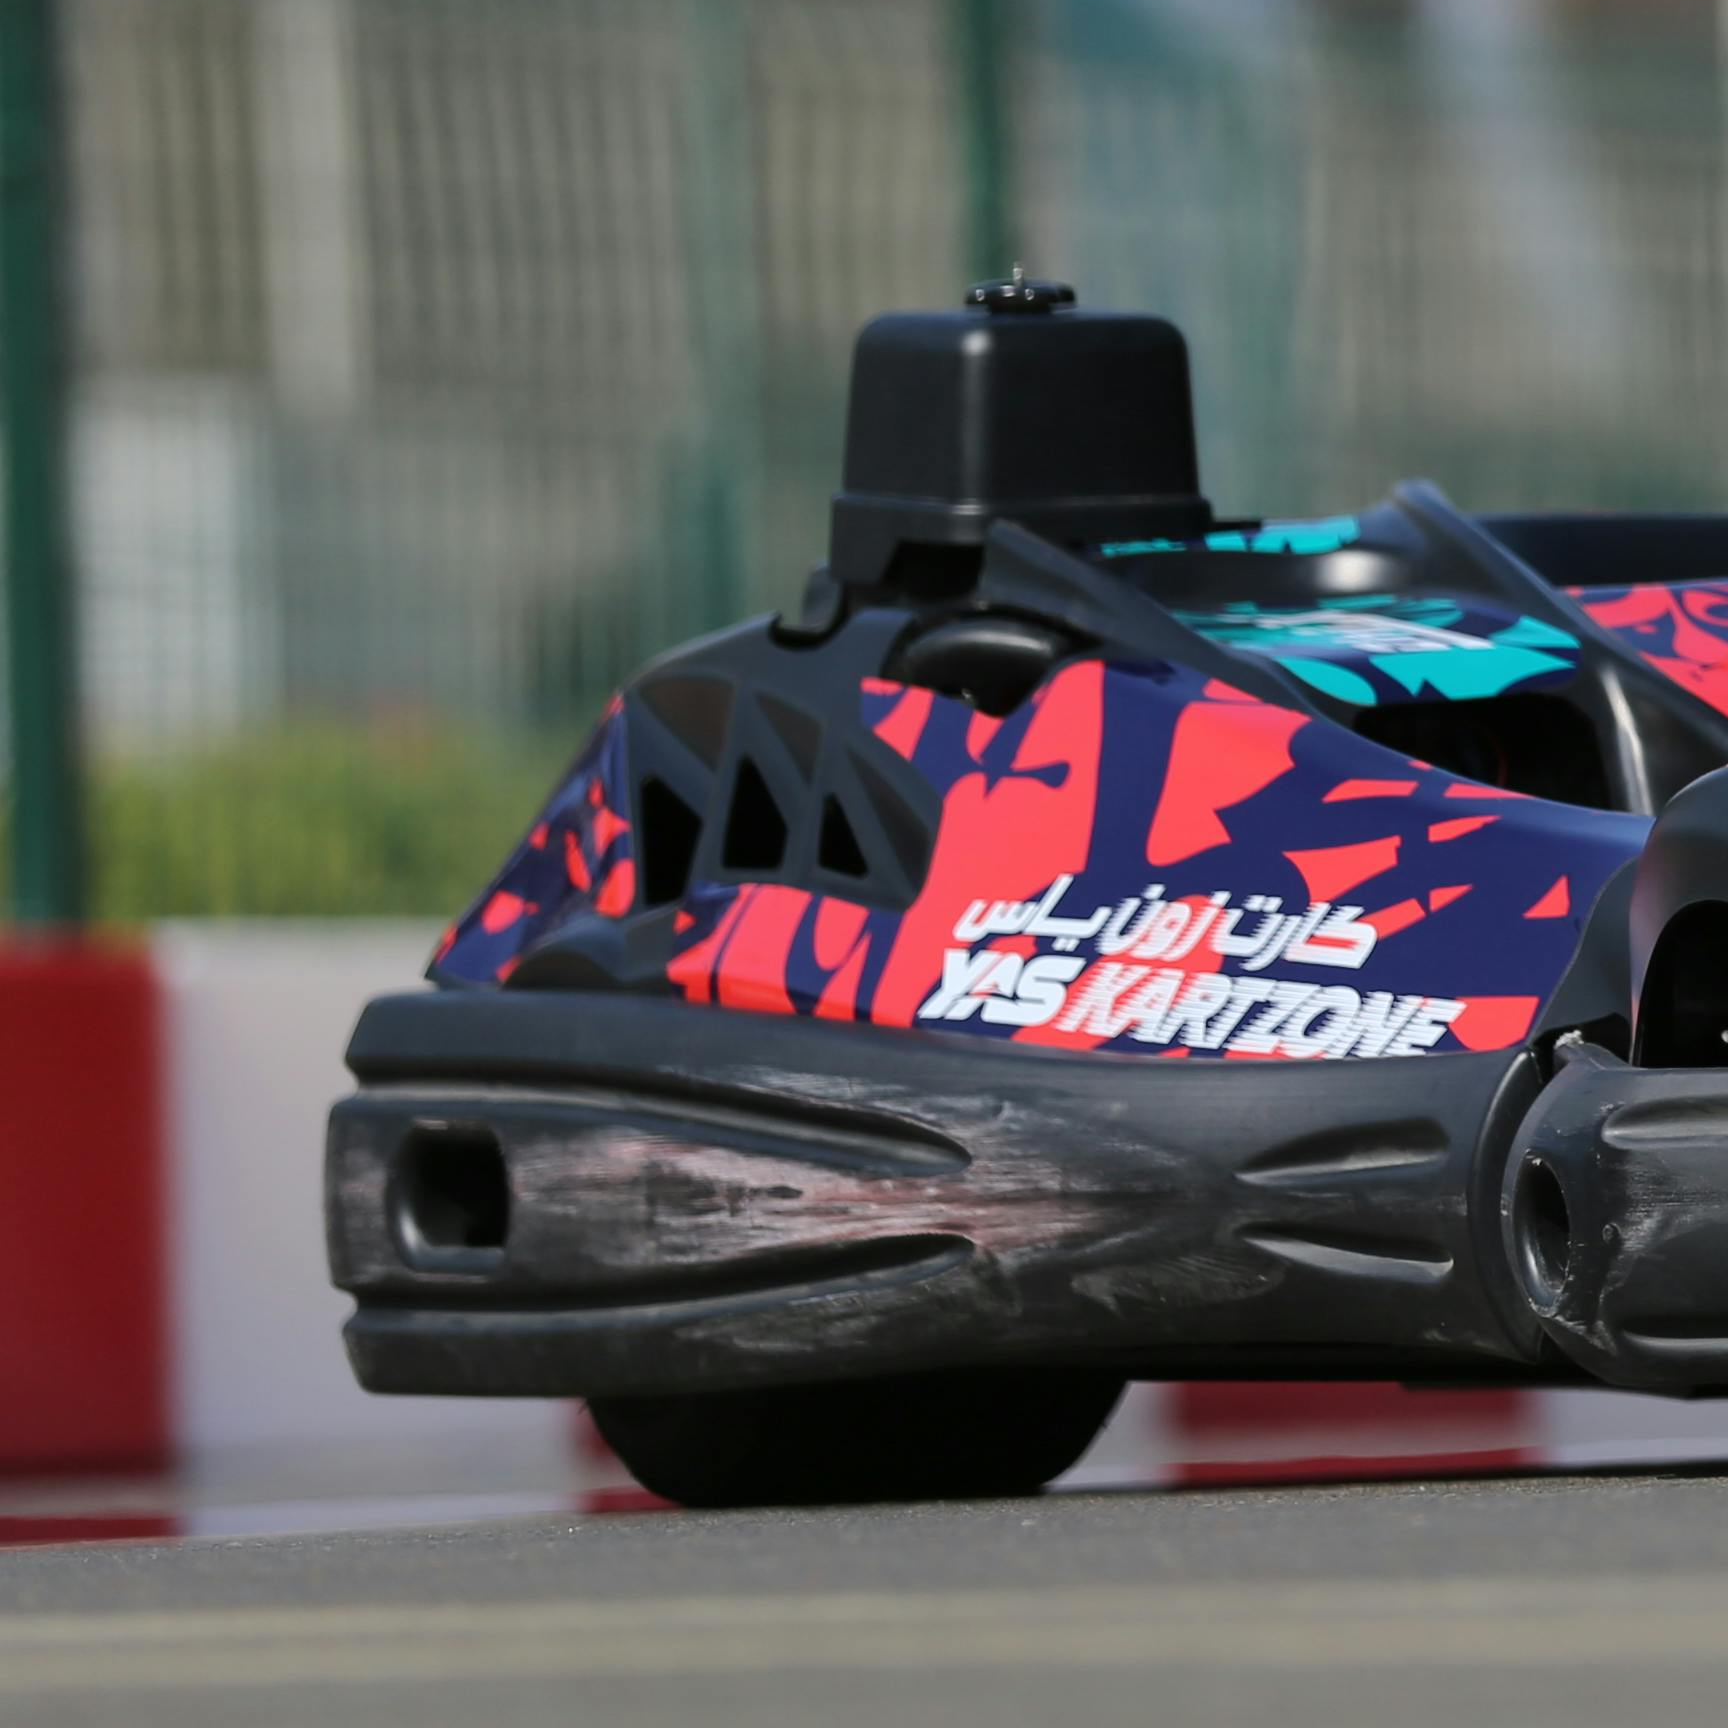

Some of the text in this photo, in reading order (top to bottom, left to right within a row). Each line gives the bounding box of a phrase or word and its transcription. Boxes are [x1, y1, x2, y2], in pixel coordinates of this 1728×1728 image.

[953, 874, 1110, 951] ياس
[918, 947, 1467, 1059] YAS KARTZONE
